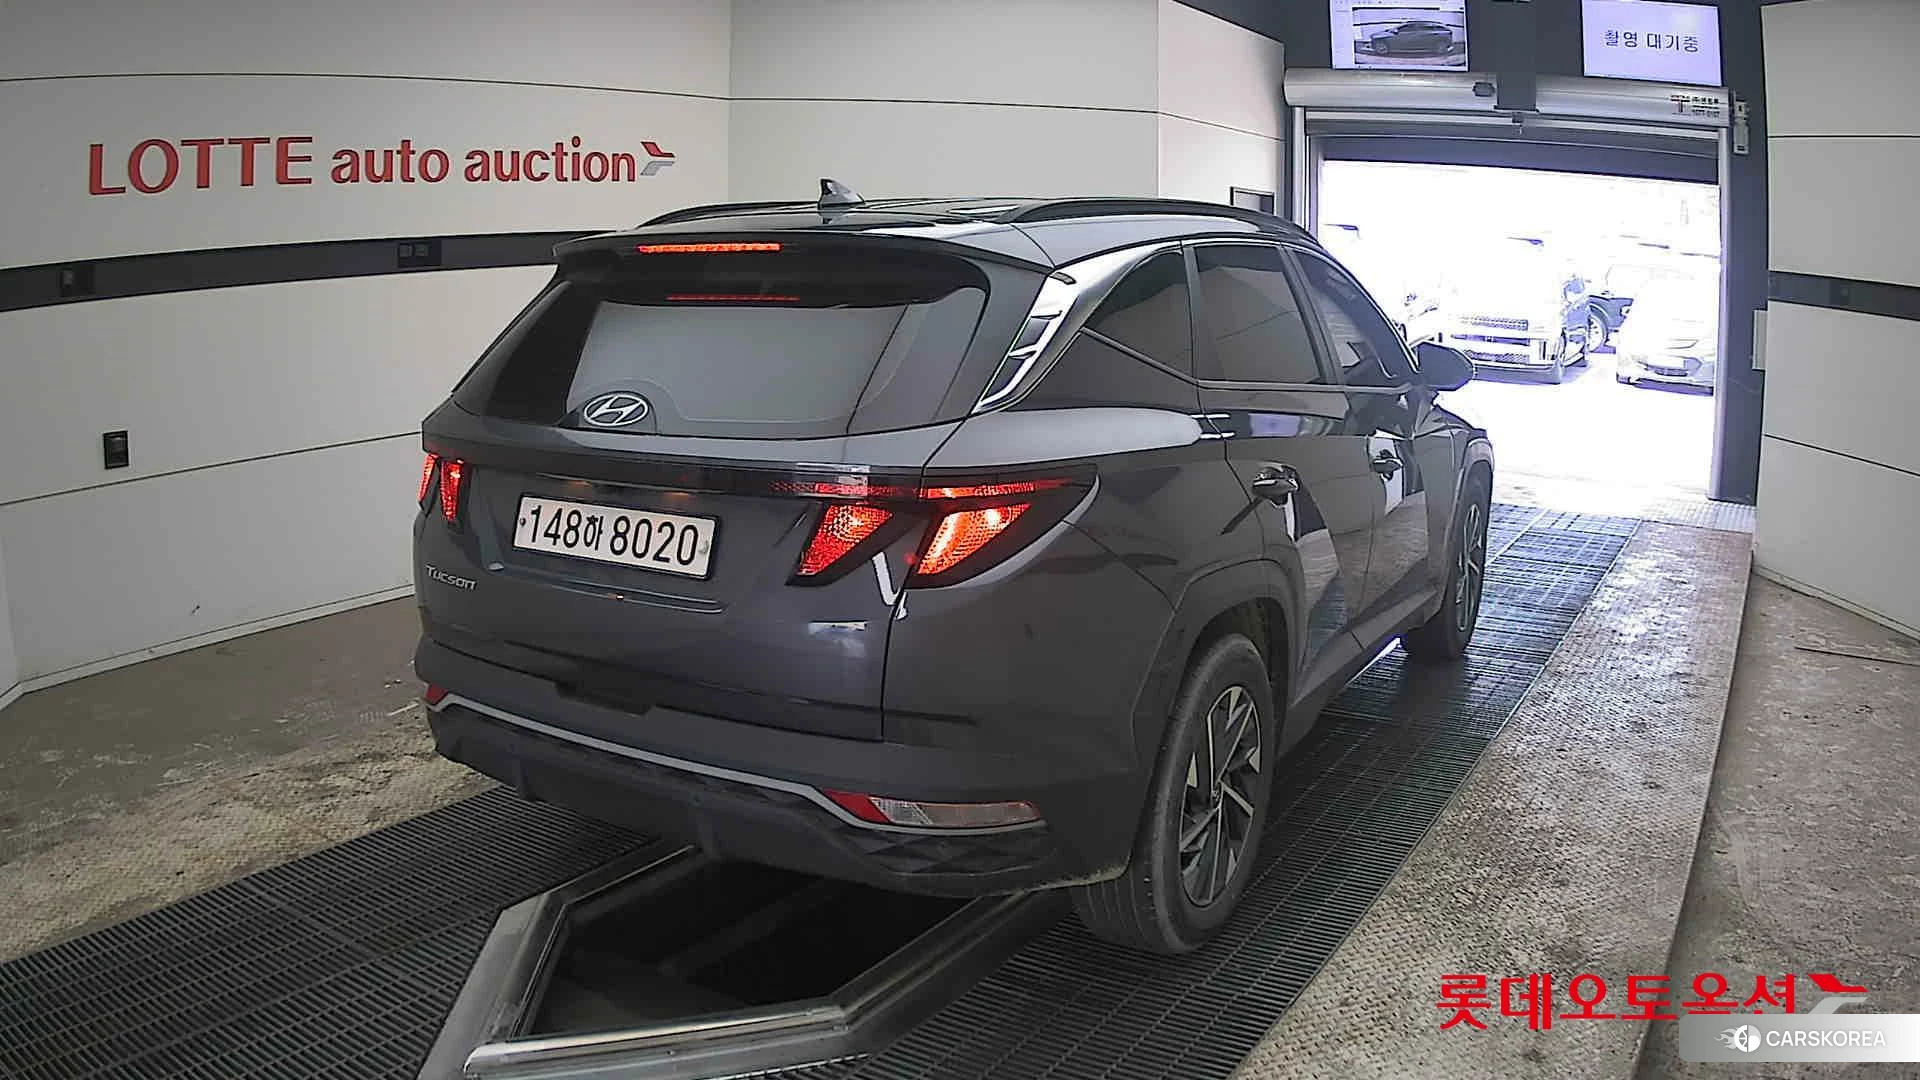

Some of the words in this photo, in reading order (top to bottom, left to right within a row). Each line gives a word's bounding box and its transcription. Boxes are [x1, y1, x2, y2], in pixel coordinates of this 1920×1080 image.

[1604, 29, 1637, 48] 촬영
[1646, 33, 1699, 53] 대기중
[88, 137, 313, 195] LOTTE
[330, 139, 451, 184] auto
[463, 136, 637, 183] auction
[609, 515, 699, 566] 8020
